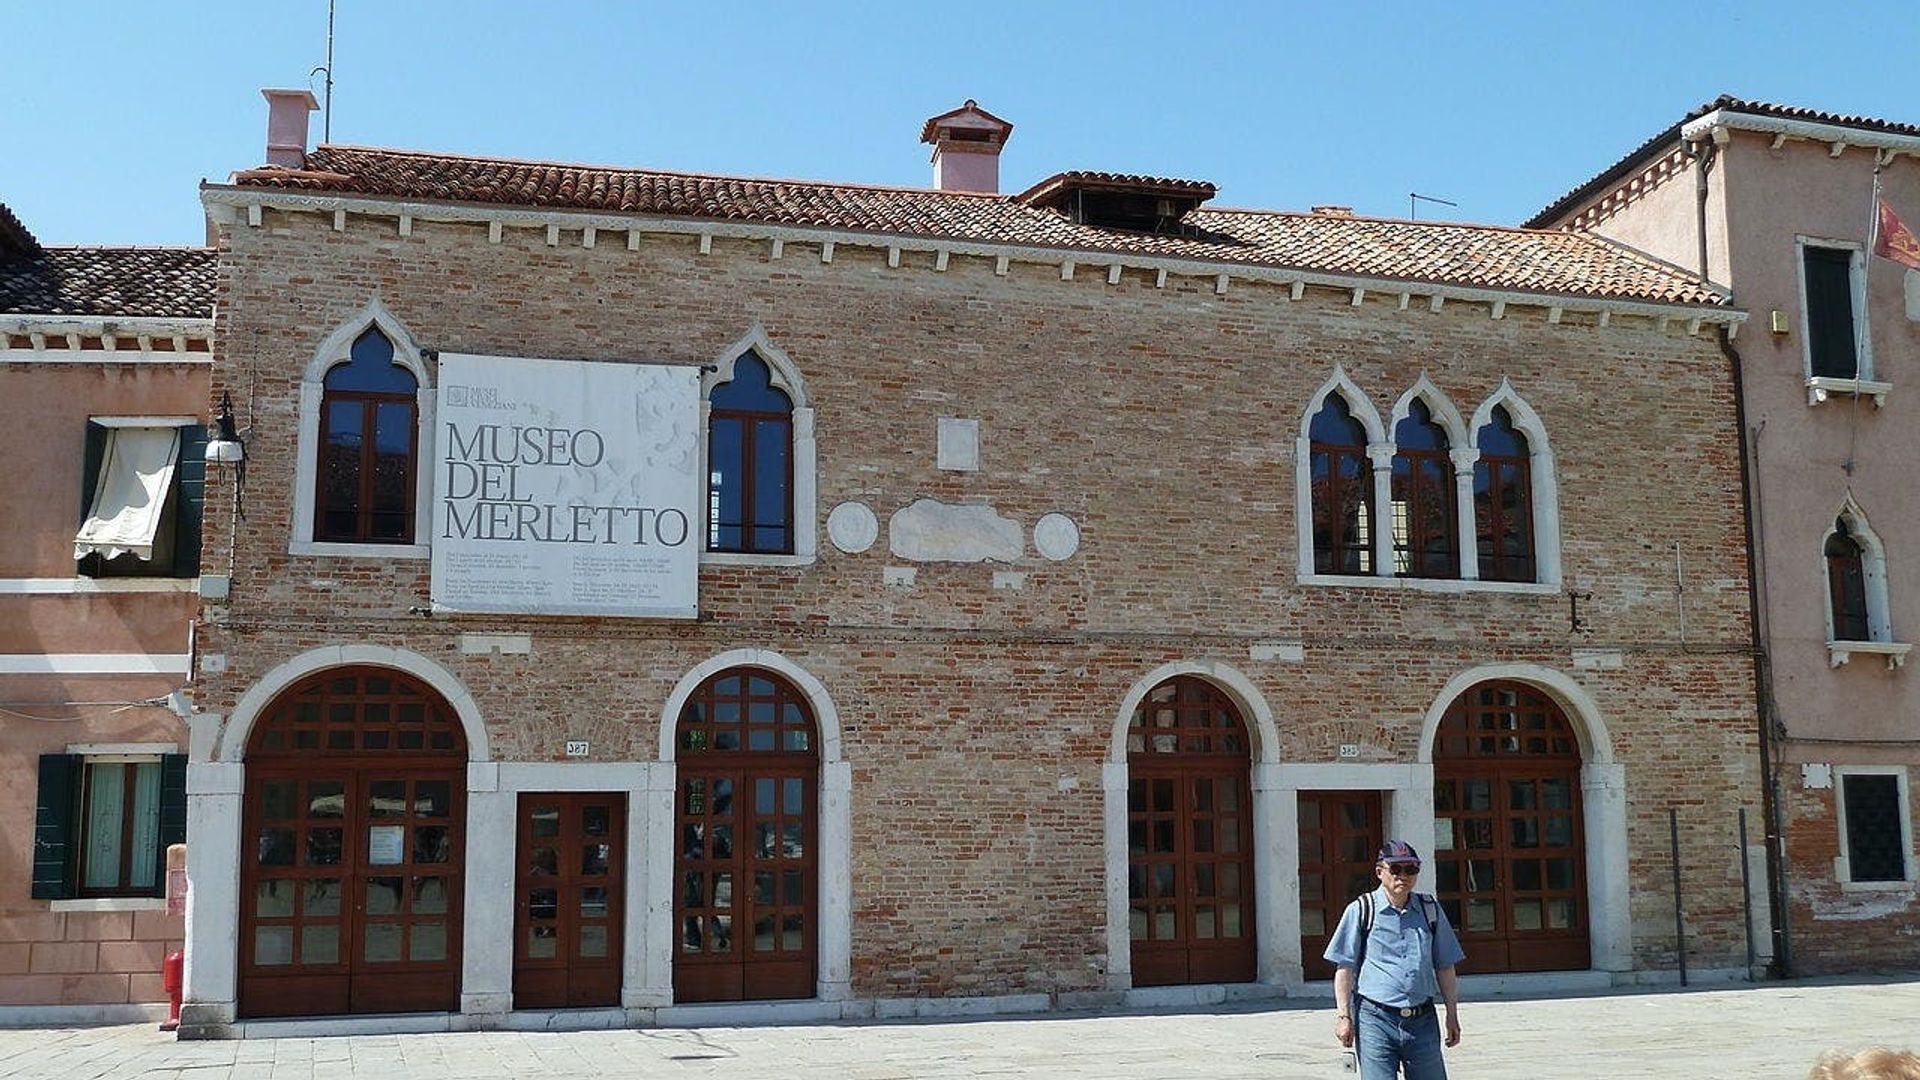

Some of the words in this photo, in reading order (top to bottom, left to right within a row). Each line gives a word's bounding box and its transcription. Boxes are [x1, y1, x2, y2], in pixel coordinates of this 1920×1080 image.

[445, 422, 605, 467] MUSEO
[444, 461, 533, 502] DEL
[442, 500, 689, 547] MERLETTO
